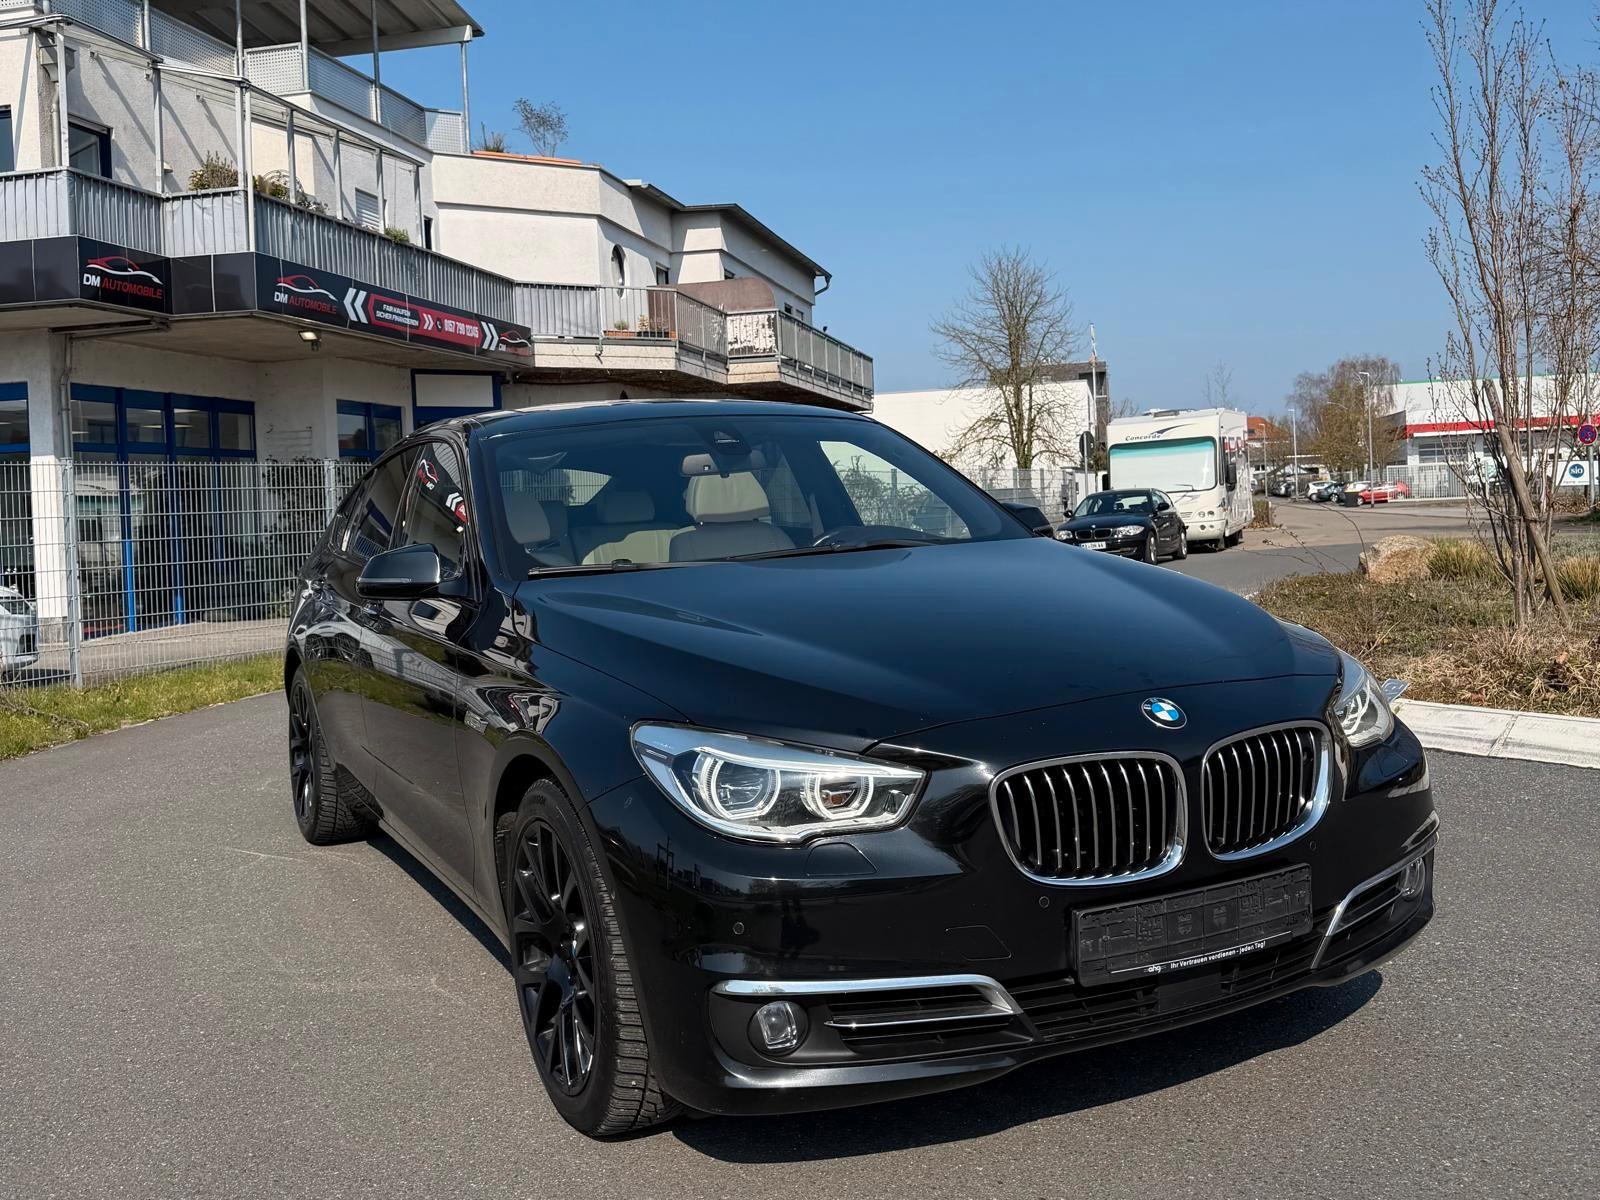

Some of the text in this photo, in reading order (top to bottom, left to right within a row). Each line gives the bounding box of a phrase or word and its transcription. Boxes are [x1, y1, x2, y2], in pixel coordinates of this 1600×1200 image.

[83, 273, 163, 299] DM AUTOMOBILE
[274, 291, 337, 314] DM AUTOMOBILE
[1180, 956, 1207, 967] Vertrauen
[1209, 949, 1236, 961] verdienen
[1240, 945, 1254, 955] jeden
[1254, 940, 1266, 950] Tag!
